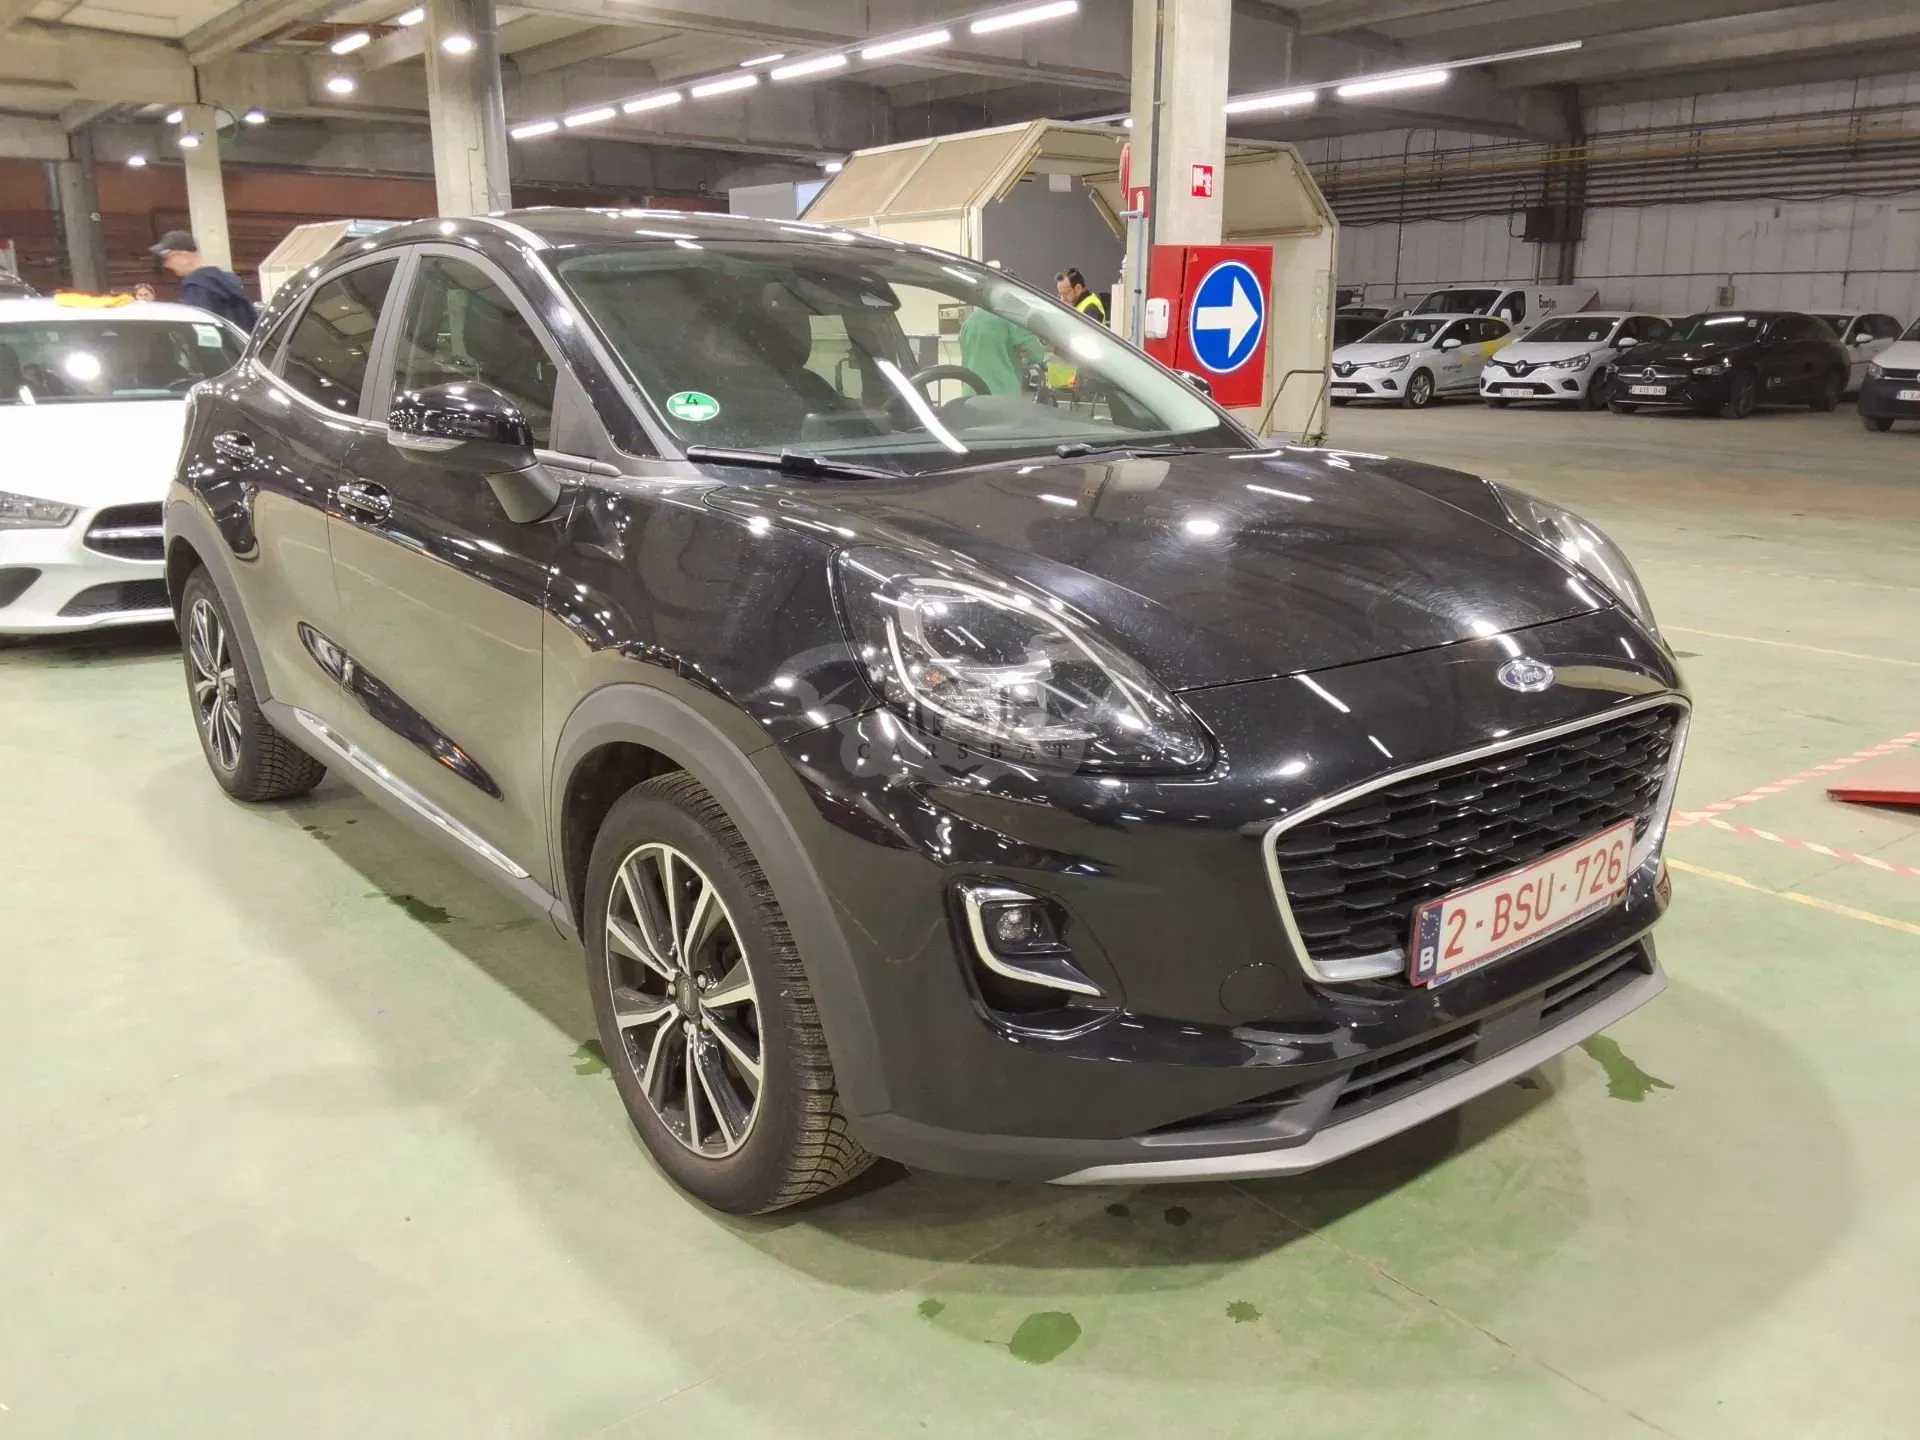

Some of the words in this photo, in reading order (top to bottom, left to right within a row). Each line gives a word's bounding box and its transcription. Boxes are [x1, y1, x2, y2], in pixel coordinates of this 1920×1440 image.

[685, 394, 699, 406] 4
[1444, 839, 1624, 960] 2-BSU-726
[1419, 946, 1434, 972] B
